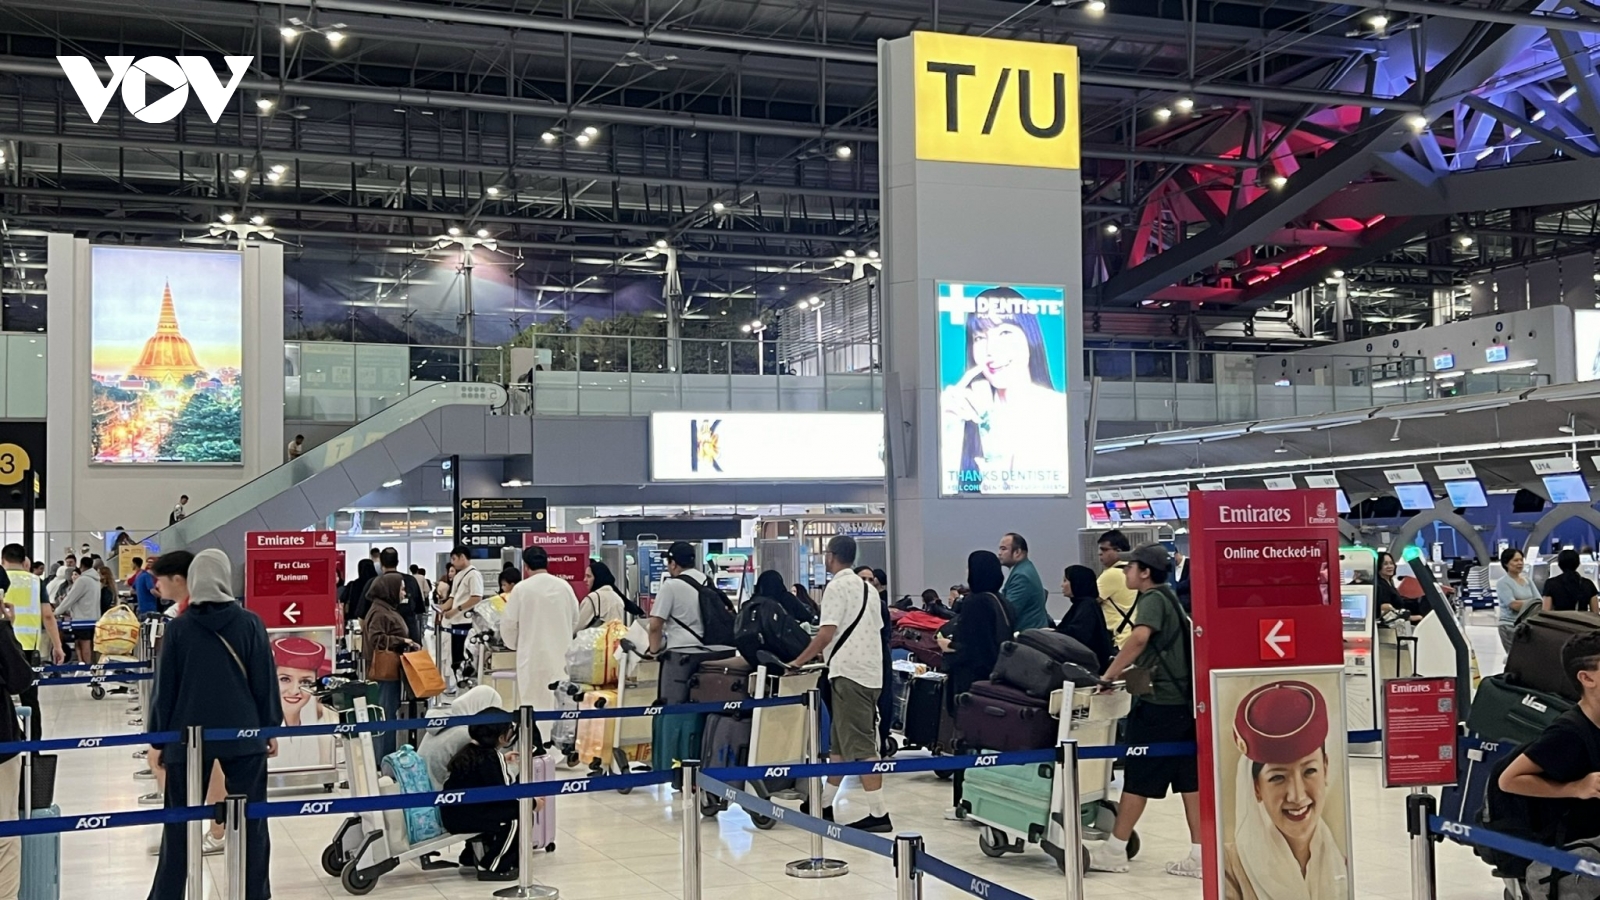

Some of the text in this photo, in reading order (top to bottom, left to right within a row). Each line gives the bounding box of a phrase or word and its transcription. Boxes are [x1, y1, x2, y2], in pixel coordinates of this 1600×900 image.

[926, 61, 1067, 140] T/U
[0, 453, 15, 475] 3
[1535, 463, 1551, 471] U14
[947, 469, 998, 482] THANKS
[1219, 504, 1291, 523] Emirates
[257, 535, 305, 546] Emirates
[533, 535, 567, 544] Emirates
[1223, 546, 1321, 559] Online Checked-in
[274, 561, 311, 570] First Class
[1391, 683, 1431, 694] Emirates
[644, 706, 663, 715] AOT
[723, 701, 743, 709] AOT
[560, 711, 581, 719] AOT
[427, 718, 449, 727] AOT
[237, 729, 260, 738] AOT
[334, 724, 356, 733] AOT
[78, 738, 102, 748] AOT
[1480, 741, 1499, 751] AOT
[1126, 746, 1149, 756] AOT
[975, 755, 998, 766] AOT
[764, 767, 791, 777] AOT
[872, 762, 897, 772] AOT
[560, 780, 591, 793] AOT
[434, 792, 466, 805] AOT
[725, 788, 737, 800] AOT
[300, 801, 333, 814] AOT
[772, 806, 785, 819] AOT
[75, 816, 111, 829] AOT
[827, 825, 842, 839] AOT
[1441, 821, 1472, 837] AOT
[970, 878, 990, 898] AOT
